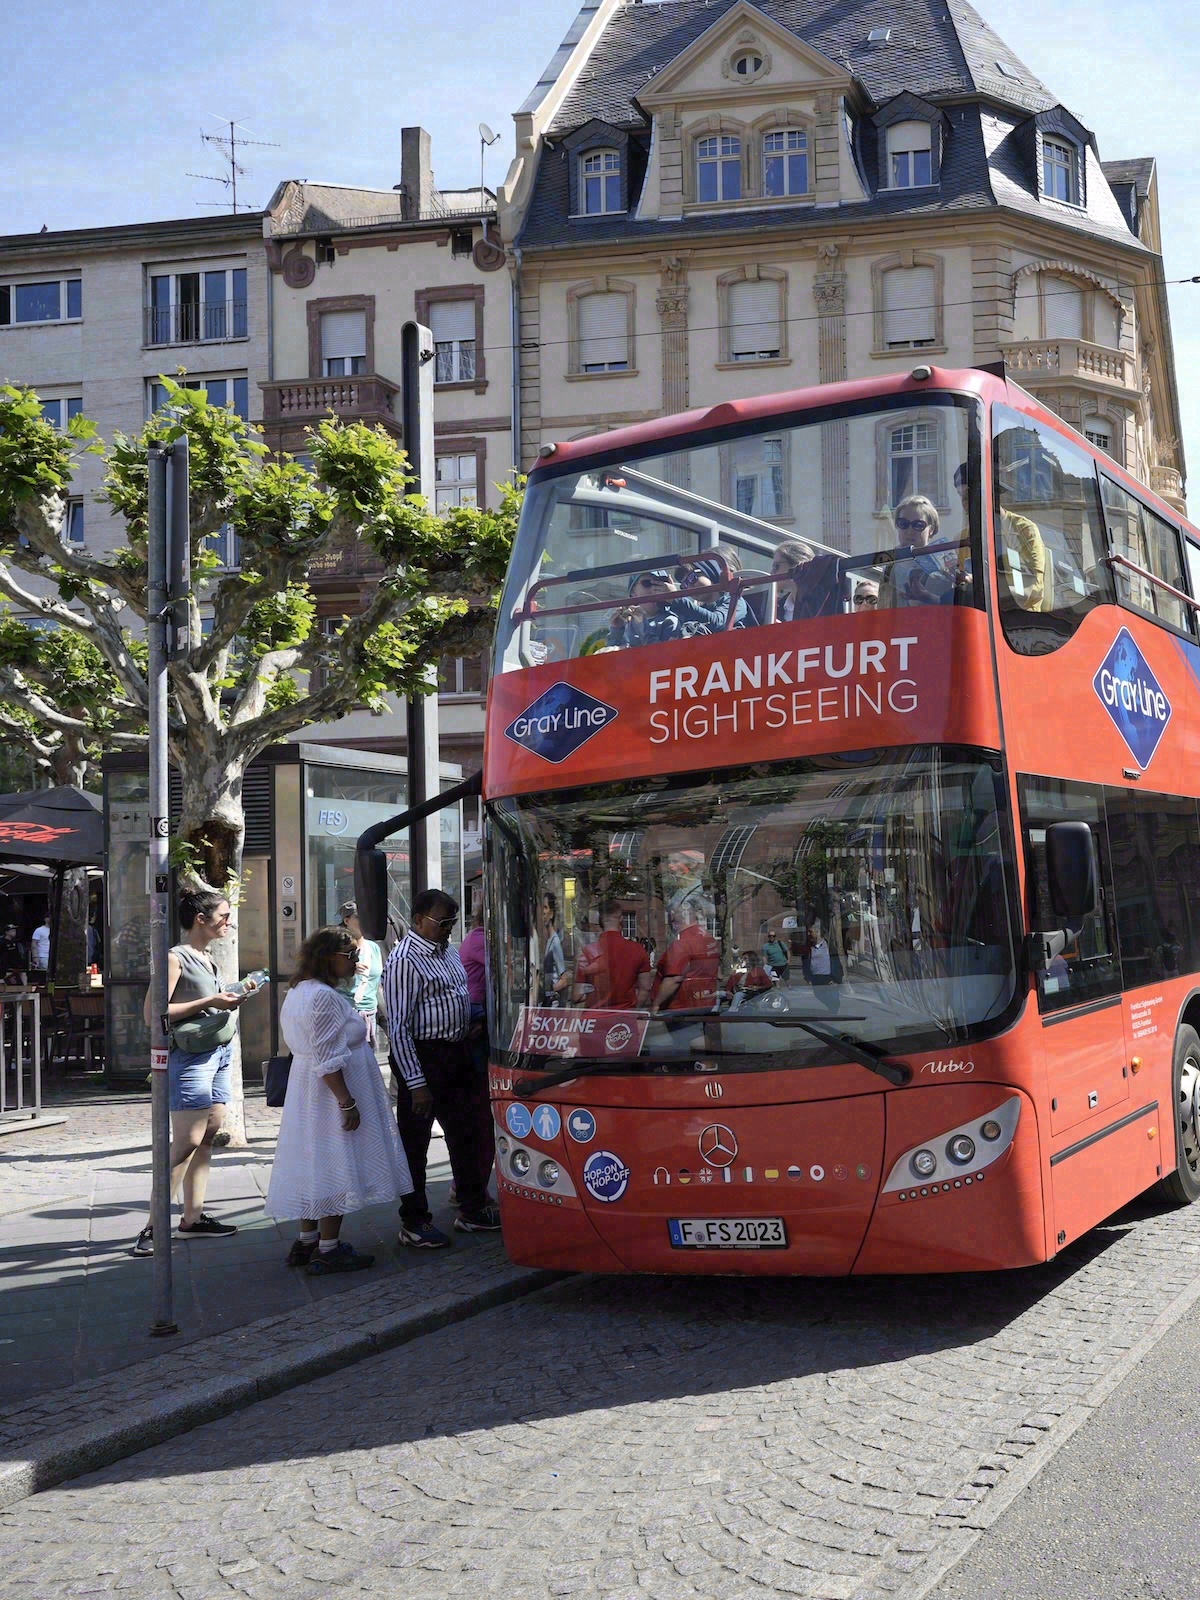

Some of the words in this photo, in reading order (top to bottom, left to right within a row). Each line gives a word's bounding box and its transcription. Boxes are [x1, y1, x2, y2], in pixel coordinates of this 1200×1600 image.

[649, 636, 918, 704] FRANKFURT
[649, 678, 918, 744] SIGHTSEEING
[319, 809, 343, 826] FES
[531, 1016, 597, 1034] SKYLINE
[527, 1034, 570, 1051] TOUR
[920, 1059, 975, 1074] Urbis
[584, 1163, 618, 1182] HOP-ON
[592, 1168, 630, 1189] HOP-OFF
[681, 1222, 693, 1242] F
[705, 1222, 732, 1242] FS
[734, 1222, 782, 1241] 2023
